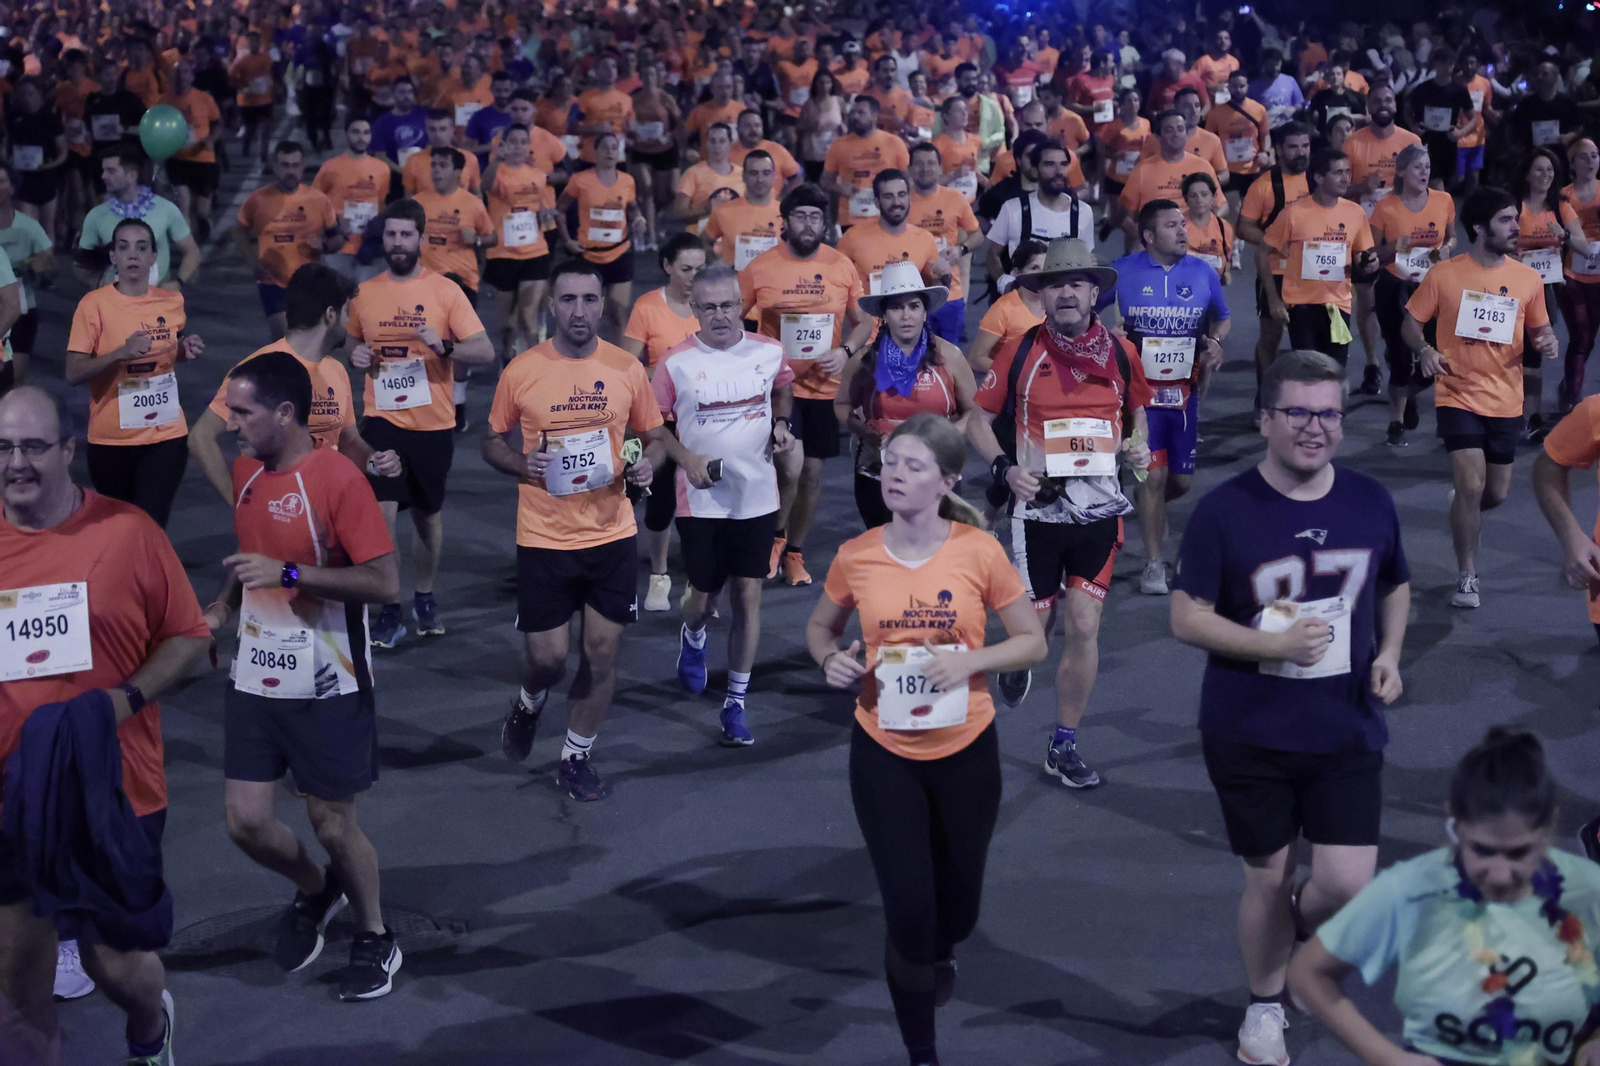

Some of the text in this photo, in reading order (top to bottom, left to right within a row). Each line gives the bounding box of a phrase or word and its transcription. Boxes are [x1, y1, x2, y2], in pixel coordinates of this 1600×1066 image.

[1315, 255, 1337, 265] 7658
[1405, 258, 1430, 269] 15483
[1128, 305, 1204, 318] INFORMALES
[1472, 307, 1506, 324] 12183
[1133, 316, 1199, 330] ALCONCHEL
[795, 329, 822, 341] 2748
[1153, 352, 1185, 363] 12173
[381, 375, 416, 390] 14609
[132, 391, 169, 408] 20035
[568, 395, 609, 403] NOCTURNA
[550, 403, 586, 413] SEVILLA
[1069, 437, 1095, 452] 619
[562, 451, 596, 471] 5752
[1081, 581, 1107, 599] CAIRS
[1034, 600, 1051, 610] IRS
[902, 609, 958, 618] NOCTURNA
[6, 613, 69, 642] 14950
[879, 619, 926, 629] SEVILLA
[250, 647, 297, 671] 20849
[895, 675, 947, 695] 1872
